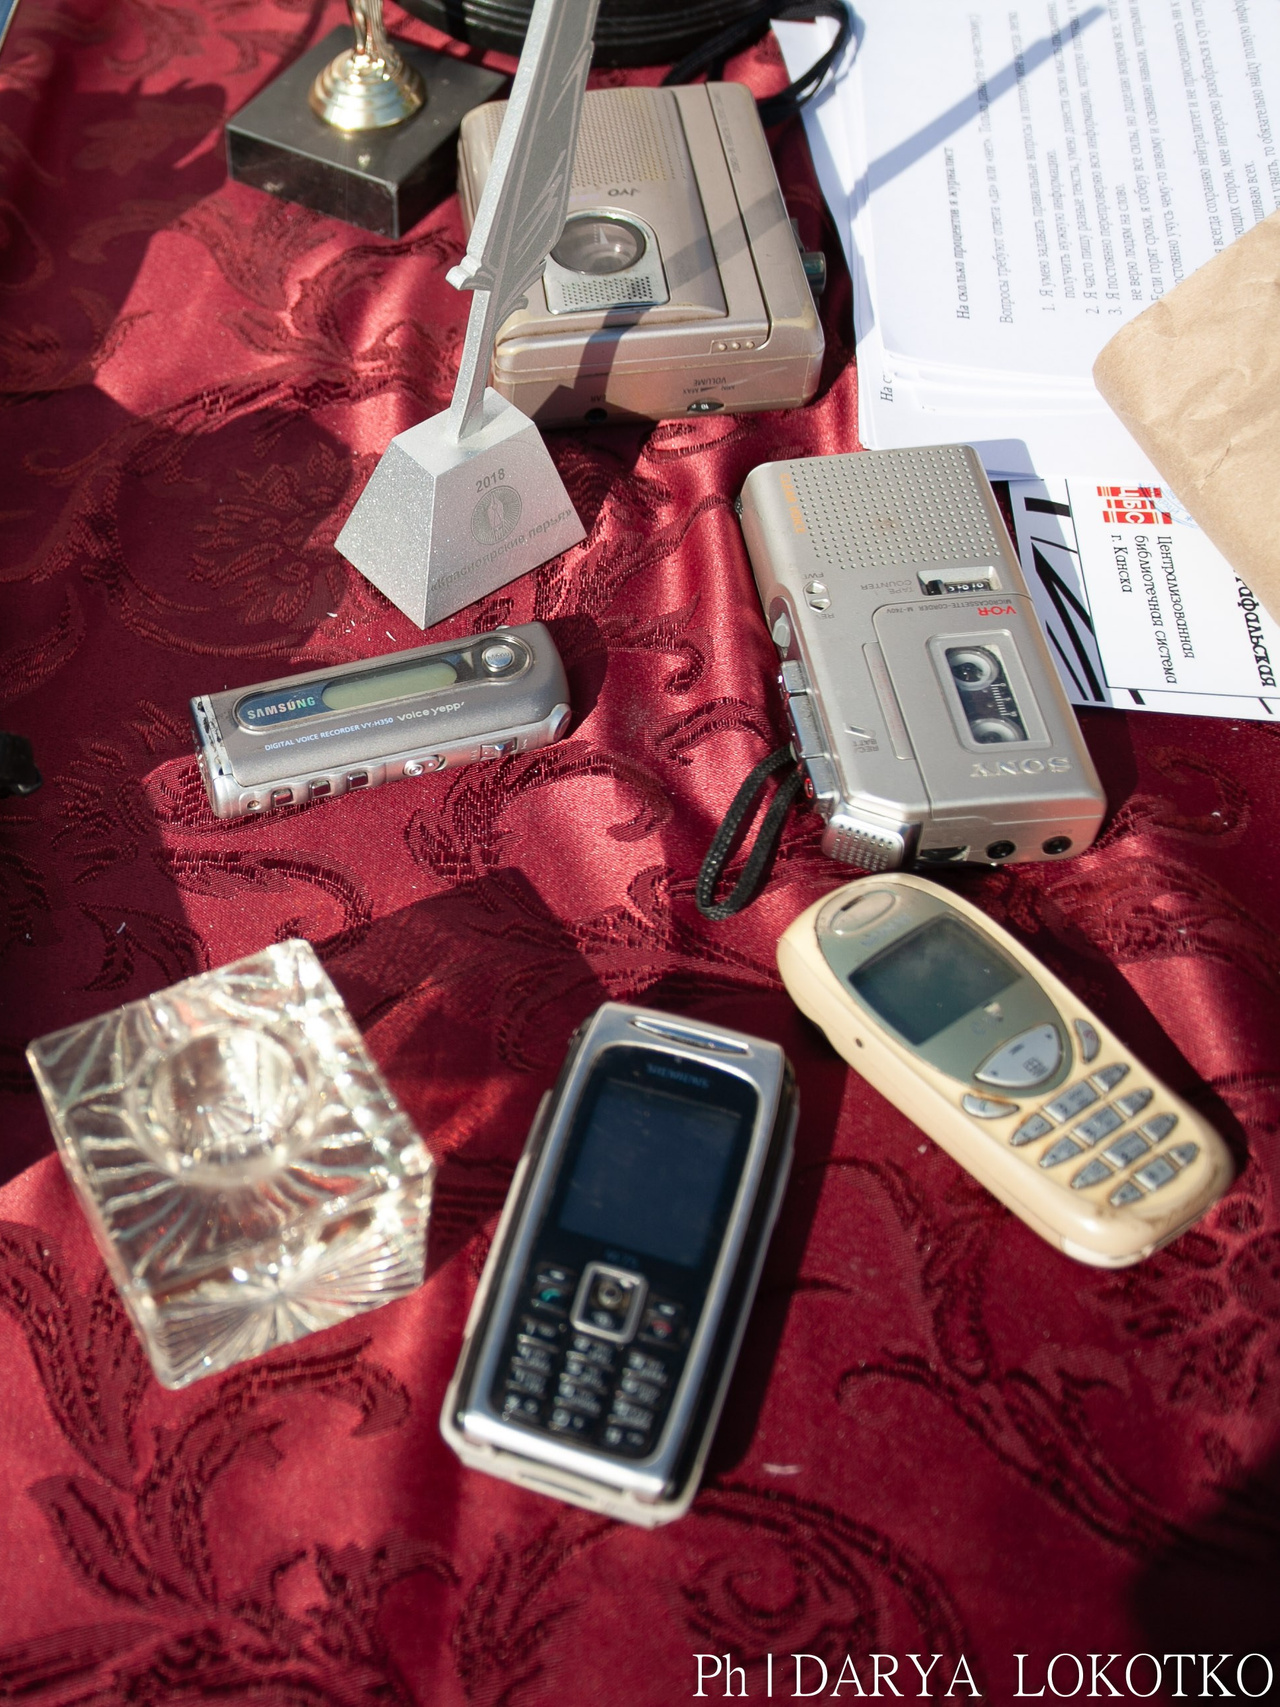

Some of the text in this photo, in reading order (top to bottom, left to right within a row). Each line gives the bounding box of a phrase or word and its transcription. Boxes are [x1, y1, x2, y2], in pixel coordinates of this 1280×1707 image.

[1195, 20, 1211, 38] сути
[1240, 26, 1256, 59] полную
[1174, 21, 1198, 87] присоединяюсь
[1200, 47, 1223, 98] разобраться
[1246, 61, 1261, 87] найду
[1186, 89, 1197, 100] не
[1210, 100, 1229, 146] интересно
[1252, 89, 1273, 145] обязательно
[1023, 124, 1039, 161] вопросы
[1065, 137, 1081, 160] умею
[1151, 136, 1166, 169] новому
[1189, 109, 1210, 166] нейтралитет
[1264, 146, 1276, 157] то
[944, 147, 961, 198] журналист
[1089, 152, 1101, 169] всю
[1133, 157, 1144, 172] все
[1219, 149, 1232, 167] мне
[1244, 160, 1258, 184] всех.
[1028, 163, 1046, 217] правильные
[1070, 163, 1082, 196] тексты,
[1134, 174, 1150, 205] соберу
[1157, 172, 1173, 208] чему-то
[1200, 168, 1220, 213] сохраняю
[1224, 169, 1240, 204] сторон,
[1073, 199, 1092, 231] разные
[1092, 171, 1113, 236] перепроверяю
[950, 209, 967, 259] процентов
[991, 207, 1003, 237] ответа
[1047, 151, 1077, 298] получить нужную информацию.
[1143, 214, 1159, 245] сроки,
[1164, 210, 1181, 237] учусь
[1208, 215, 1224, 246] всегда
[1035, 220, 1049, 258] задавать
[1079, 234, 1093, 259] пишу
[1116, 183, 1143, 301] не верю людям на слово.
[992, 238, 1011, 277] требуют
[1101, 240, 1118, 290] постоянно
[1147, 248, 1163, 274] горят
[1168, 240, 1185, 284] остоянно
[955, 261, 969, 303] сколько
[1040, 260, 1056, 287] умею
[1083, 263, 1096, 288] часто
[1150, 277, 1164, 301] Если
[999, 280, 1015, 324] Вопросы
[1039, 289, 1053, 298] Я
[1105, 292, 1120, 300] Я
[956, 305, 970, 319] На
[1086, 306, 1100, 314] 2.
[1108, 306, 1122, 315] 3.
[694, 377, 727, 386] VOLUME
[879, 387, 893, 402] На
[475, 468, 505, 493] 2018
[431, 509, 571, 592] «Красноярские перья»
[1111, 534, 1133, 593] г. Канска
[860, 580, 913, 591] COUNTER
[1157, 536, 1195, 658] Централизованная
[919, 598, 1012, 611] MICROCASSETTE-CORDER
[1135, 535, 1177, 684] библиотечная система
[247, 696, 316, 720] SAMSUNG
[264, 739, 295, 751] DIGITAL
[295, 733, 320, 745] VOICE
[320, 724, 360, 739] RECORDER
[970, 757, 1071, 777] SONY
